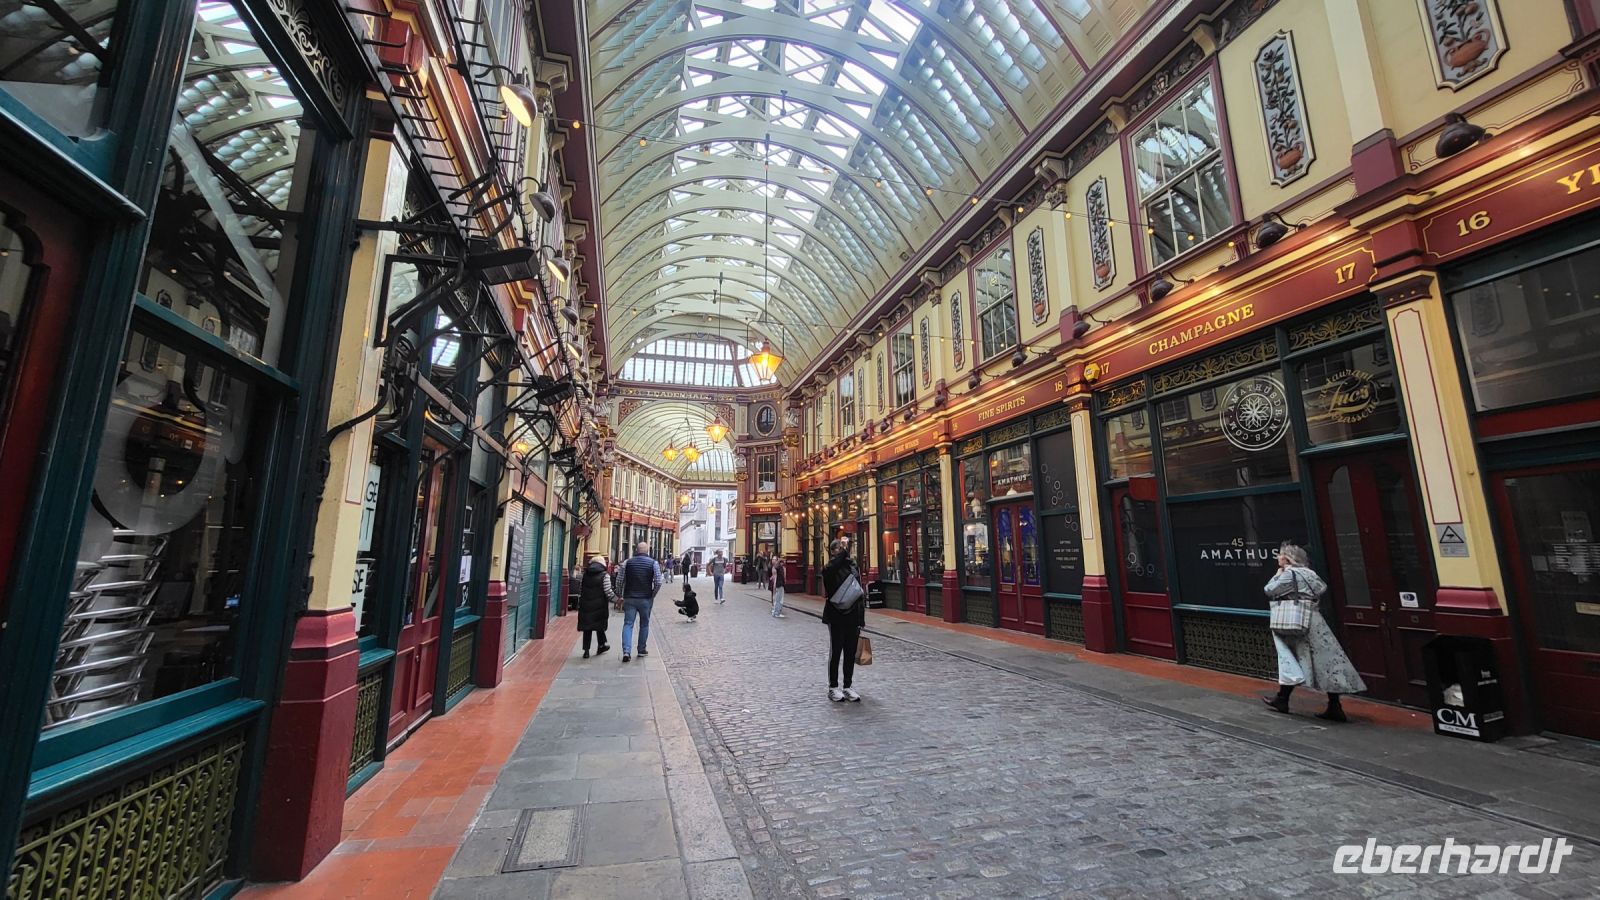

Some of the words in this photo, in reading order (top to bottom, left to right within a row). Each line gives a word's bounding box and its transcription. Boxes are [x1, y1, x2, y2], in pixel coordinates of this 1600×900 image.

[1456, 211, 1491, 237] 16
[1335, 262, 1356, 284] 17
[1148, 303, 1255, 356] CHAMPAGNE
[1101, 362, 1110, 375] 17
[1055, 381, 1063, 392] 18
[978, 408, 995, 422] FINE
[996, 396, 1025, 414] SPIRITS
[998, 474, 1027, 486] AMATHUS
[1231, 538, 1244, 547] 45
[1200, 548, 1280, 560] AMATHUS
[1437, 708, 1479, 729] CM
